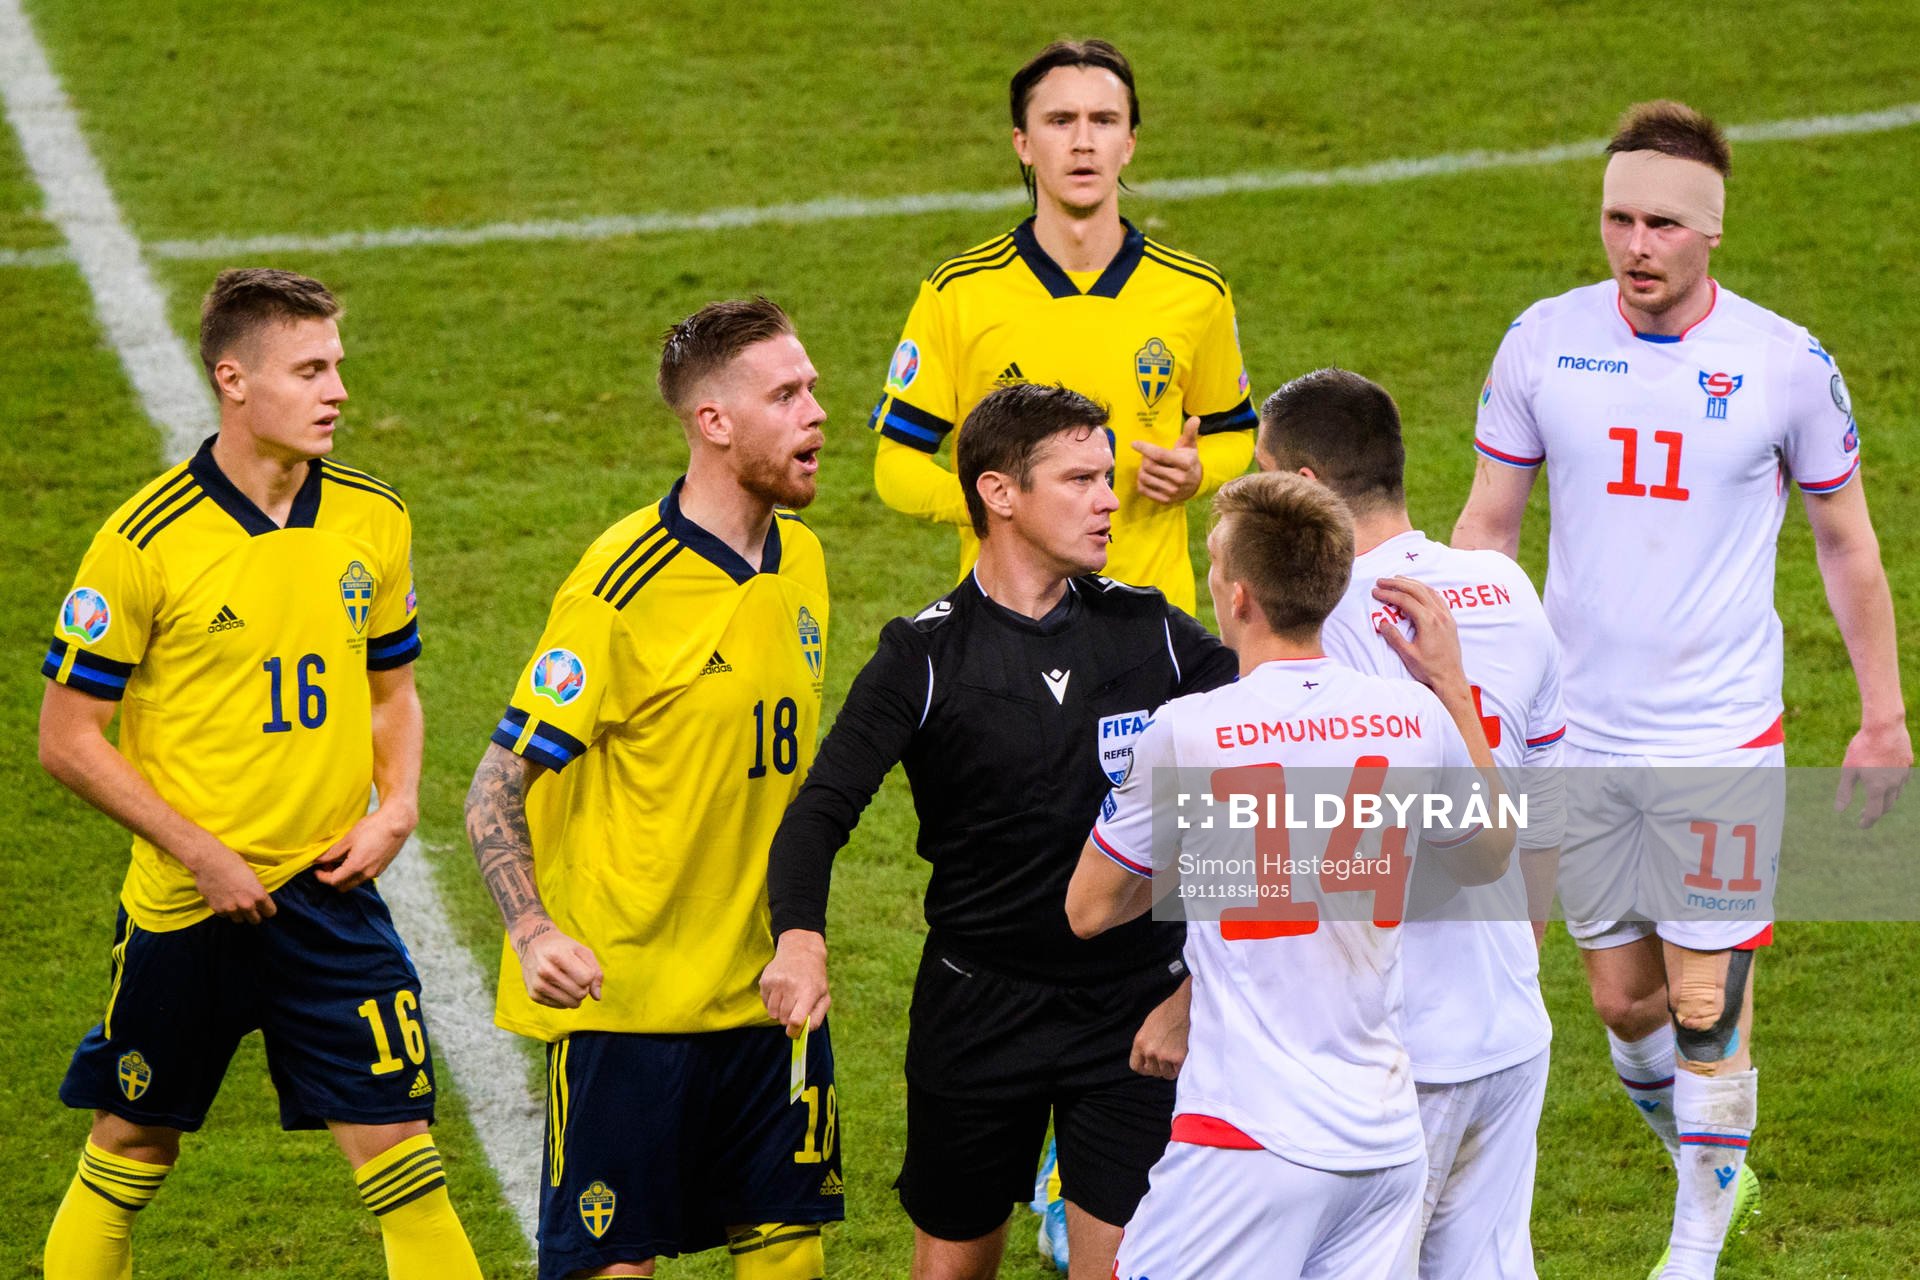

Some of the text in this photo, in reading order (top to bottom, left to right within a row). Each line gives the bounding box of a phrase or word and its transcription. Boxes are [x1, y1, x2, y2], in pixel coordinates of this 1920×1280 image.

[1557, 355, 1629, 375] macron
[1606, 426, 1690, 502] 11
[207, 618, 246, 634] adidas
[262, 653, 328, 734] 16
[1103, 716, 1144, 739] FIFA
[748, 696, 798, 779] 18
[1215, 714, 1422, 749] EDMUNDSSON
[1210, 756, 1412, 941] 14
[1683, 820, 1762, 892] 11
[1687, 893, 1756, 911] macron
[358, 989, 426, 1075] 16
[794, 1083, 836, 1163] 18
